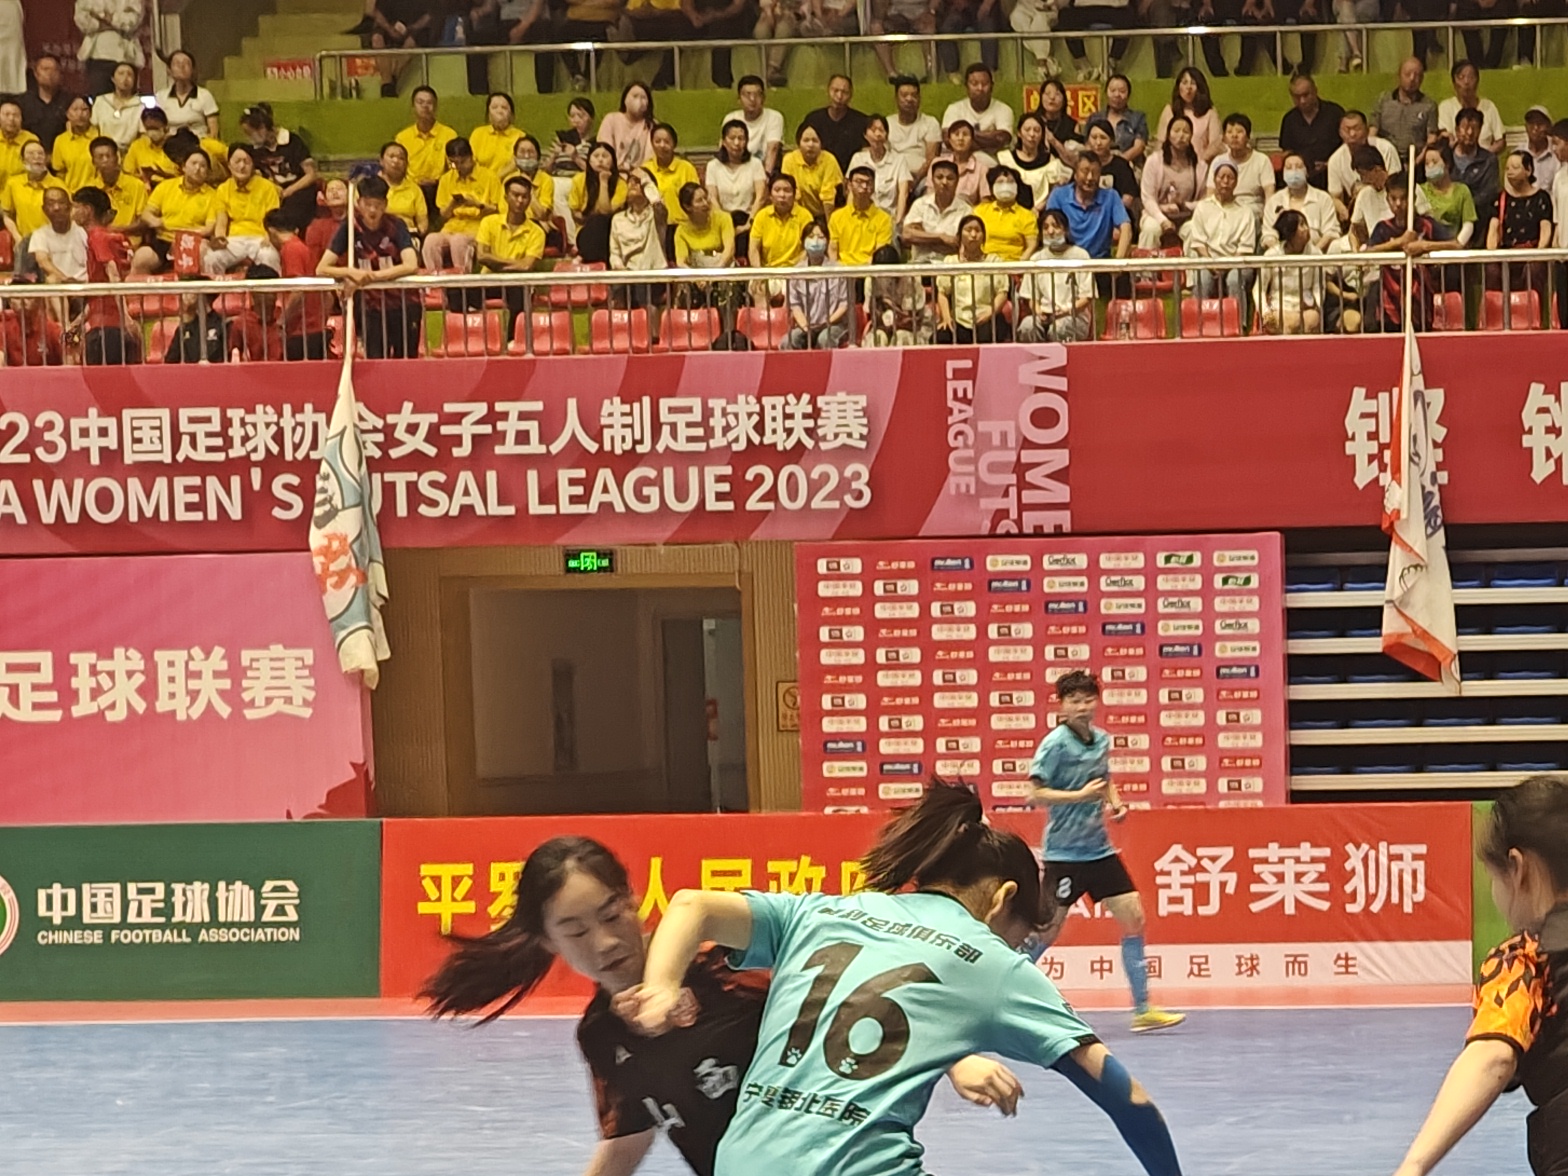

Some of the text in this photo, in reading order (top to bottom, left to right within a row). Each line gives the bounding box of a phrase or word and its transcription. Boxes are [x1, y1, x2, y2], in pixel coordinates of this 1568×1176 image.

[946, 359, 976, 495] LEAGUE
[33, 466, 304, 525] WOMEN'S
[316, 469, 516, 519] TSAL
[527, 466, 735, 516] LEAGUE
[744, 463, 872, 512] 2023
[0, 644, 316, 722] 足球联赛
[37, 880, 300, 925] 中国足球协会
[1056, 877, 1072, 898] 8
[1154, 841, 1428, 917] 舒莱狮
[37, 927, 300, 945] CHINESE FOOTBALL ASSOCIATION
[779, 940, 943, 1080] 16
